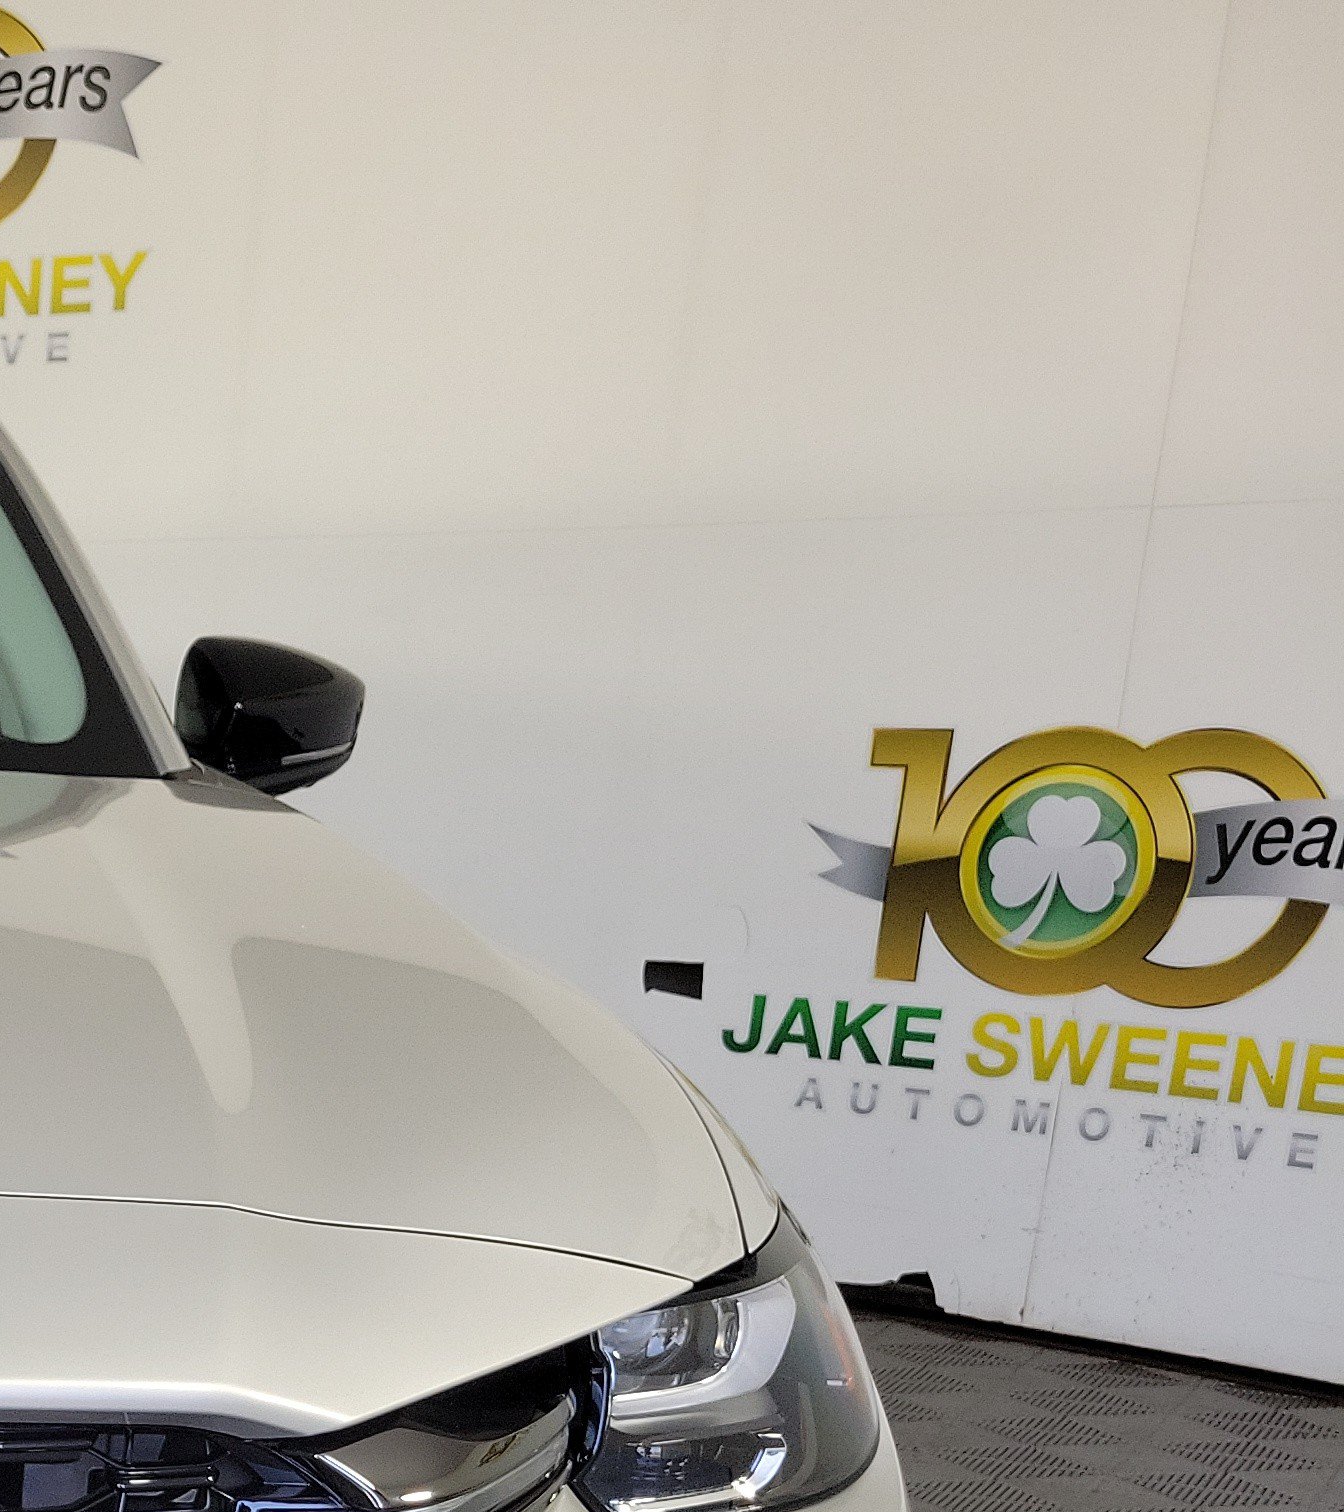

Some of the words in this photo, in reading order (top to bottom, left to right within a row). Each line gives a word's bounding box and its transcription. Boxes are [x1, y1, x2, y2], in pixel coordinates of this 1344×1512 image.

[1204, 815, 1344, 885] yea
[721, 994, 944, 1071] JAKE
[794, 1078, 1320, 1170] AUTOMOTIVE
